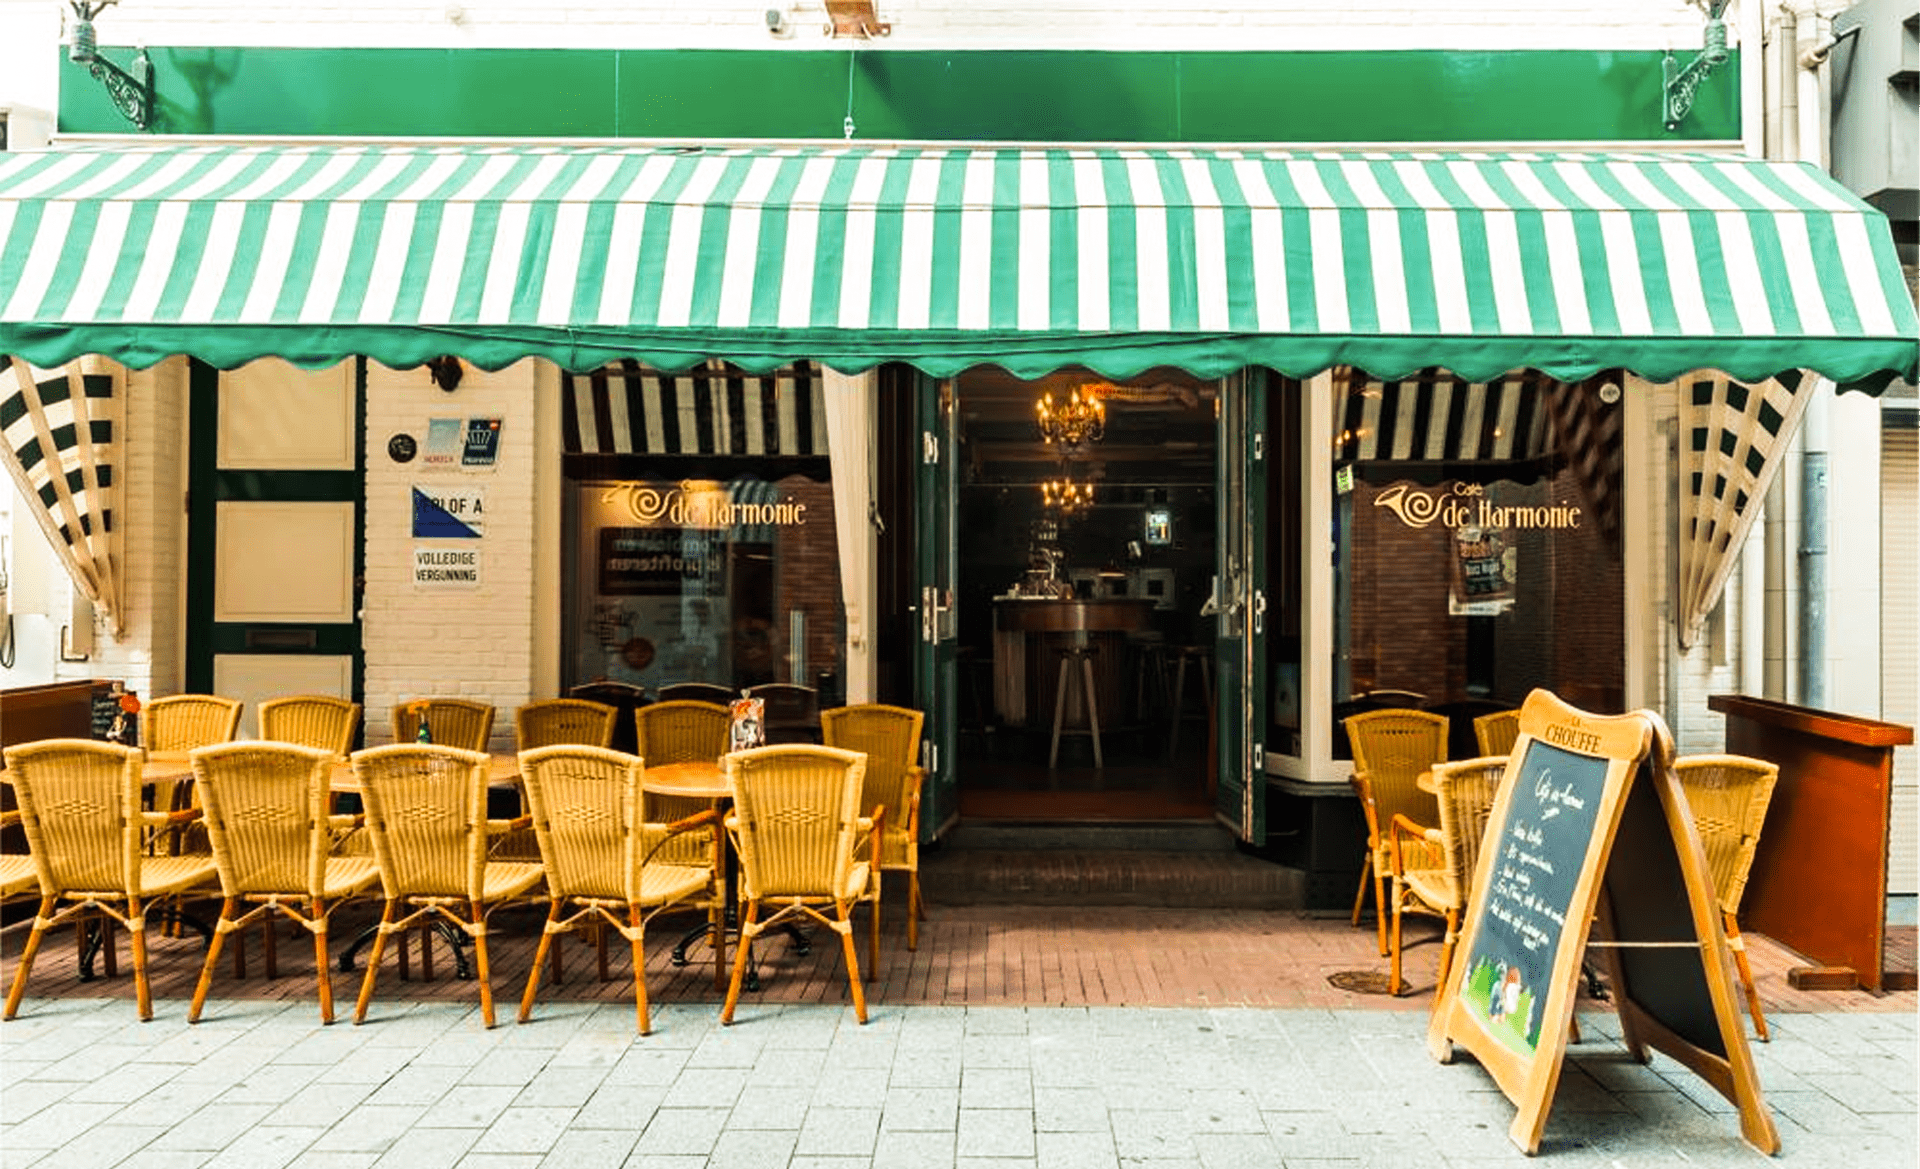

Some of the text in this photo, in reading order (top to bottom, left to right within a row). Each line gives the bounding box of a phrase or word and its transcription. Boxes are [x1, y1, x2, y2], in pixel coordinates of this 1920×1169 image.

[473, 498, 483, 514] A
[1442, 499, 1581, 529] de Harmonie
[416, 552, 476, 565] VOLLEDIGE
[416, 569, 477, 582] VERGUNNING
[1545, 723, 1602, 753] CHOUFFE
